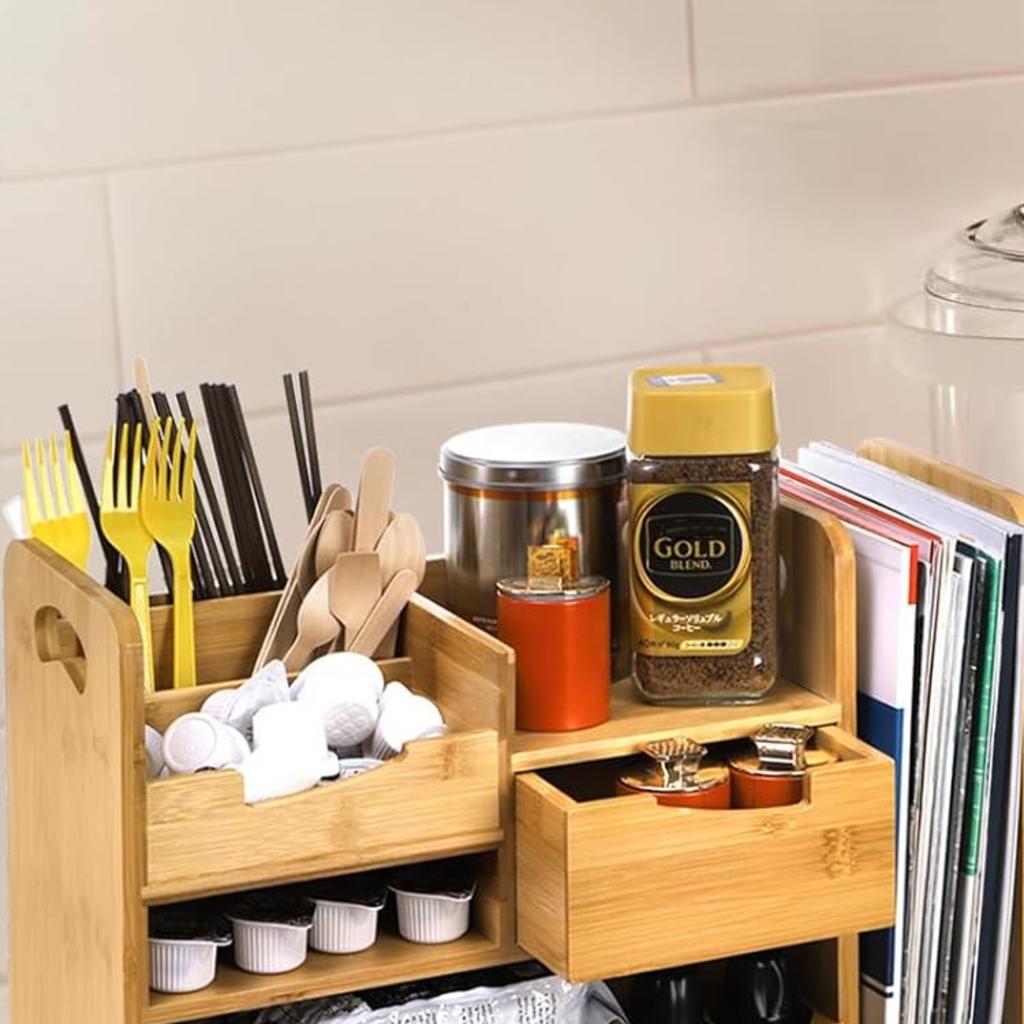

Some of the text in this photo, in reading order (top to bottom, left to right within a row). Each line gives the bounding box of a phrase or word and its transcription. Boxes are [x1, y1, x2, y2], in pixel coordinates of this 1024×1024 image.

[654, 536, 726, 558] GOLD
[672, 623, 701, 632] コーヒー
